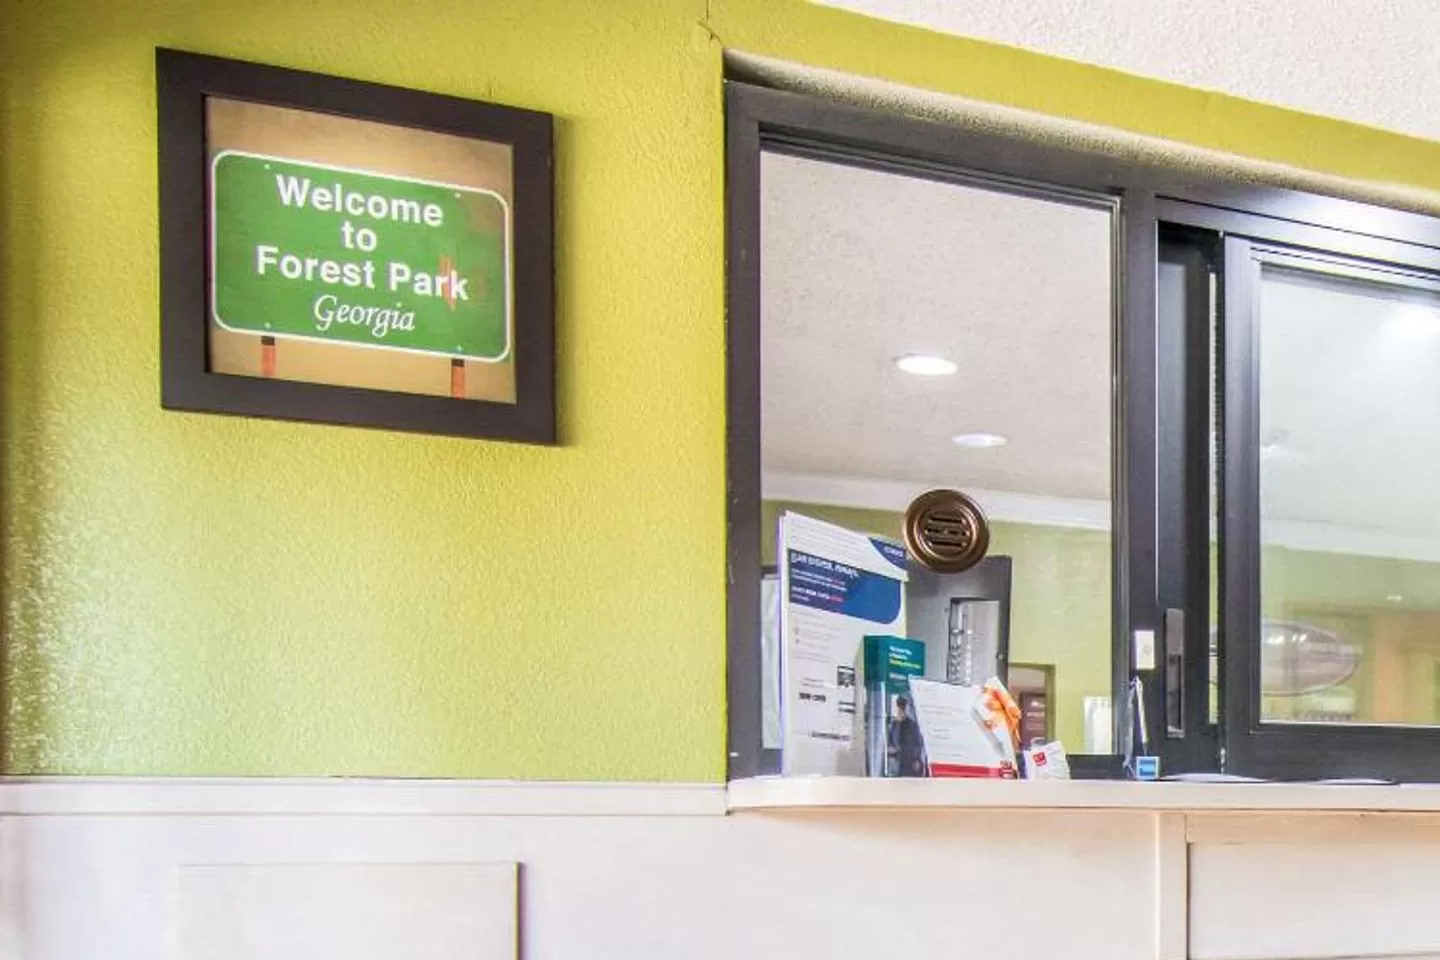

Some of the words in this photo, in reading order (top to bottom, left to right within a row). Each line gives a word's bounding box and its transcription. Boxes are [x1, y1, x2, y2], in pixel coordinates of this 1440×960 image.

[276, 173, 443, 227] Welcome
[341, 220, 377, 252] to
[256, 244, 375, 289] Forest
[389, 262, 469, 301] Park
[313, 295, 416, 337] Georgia
